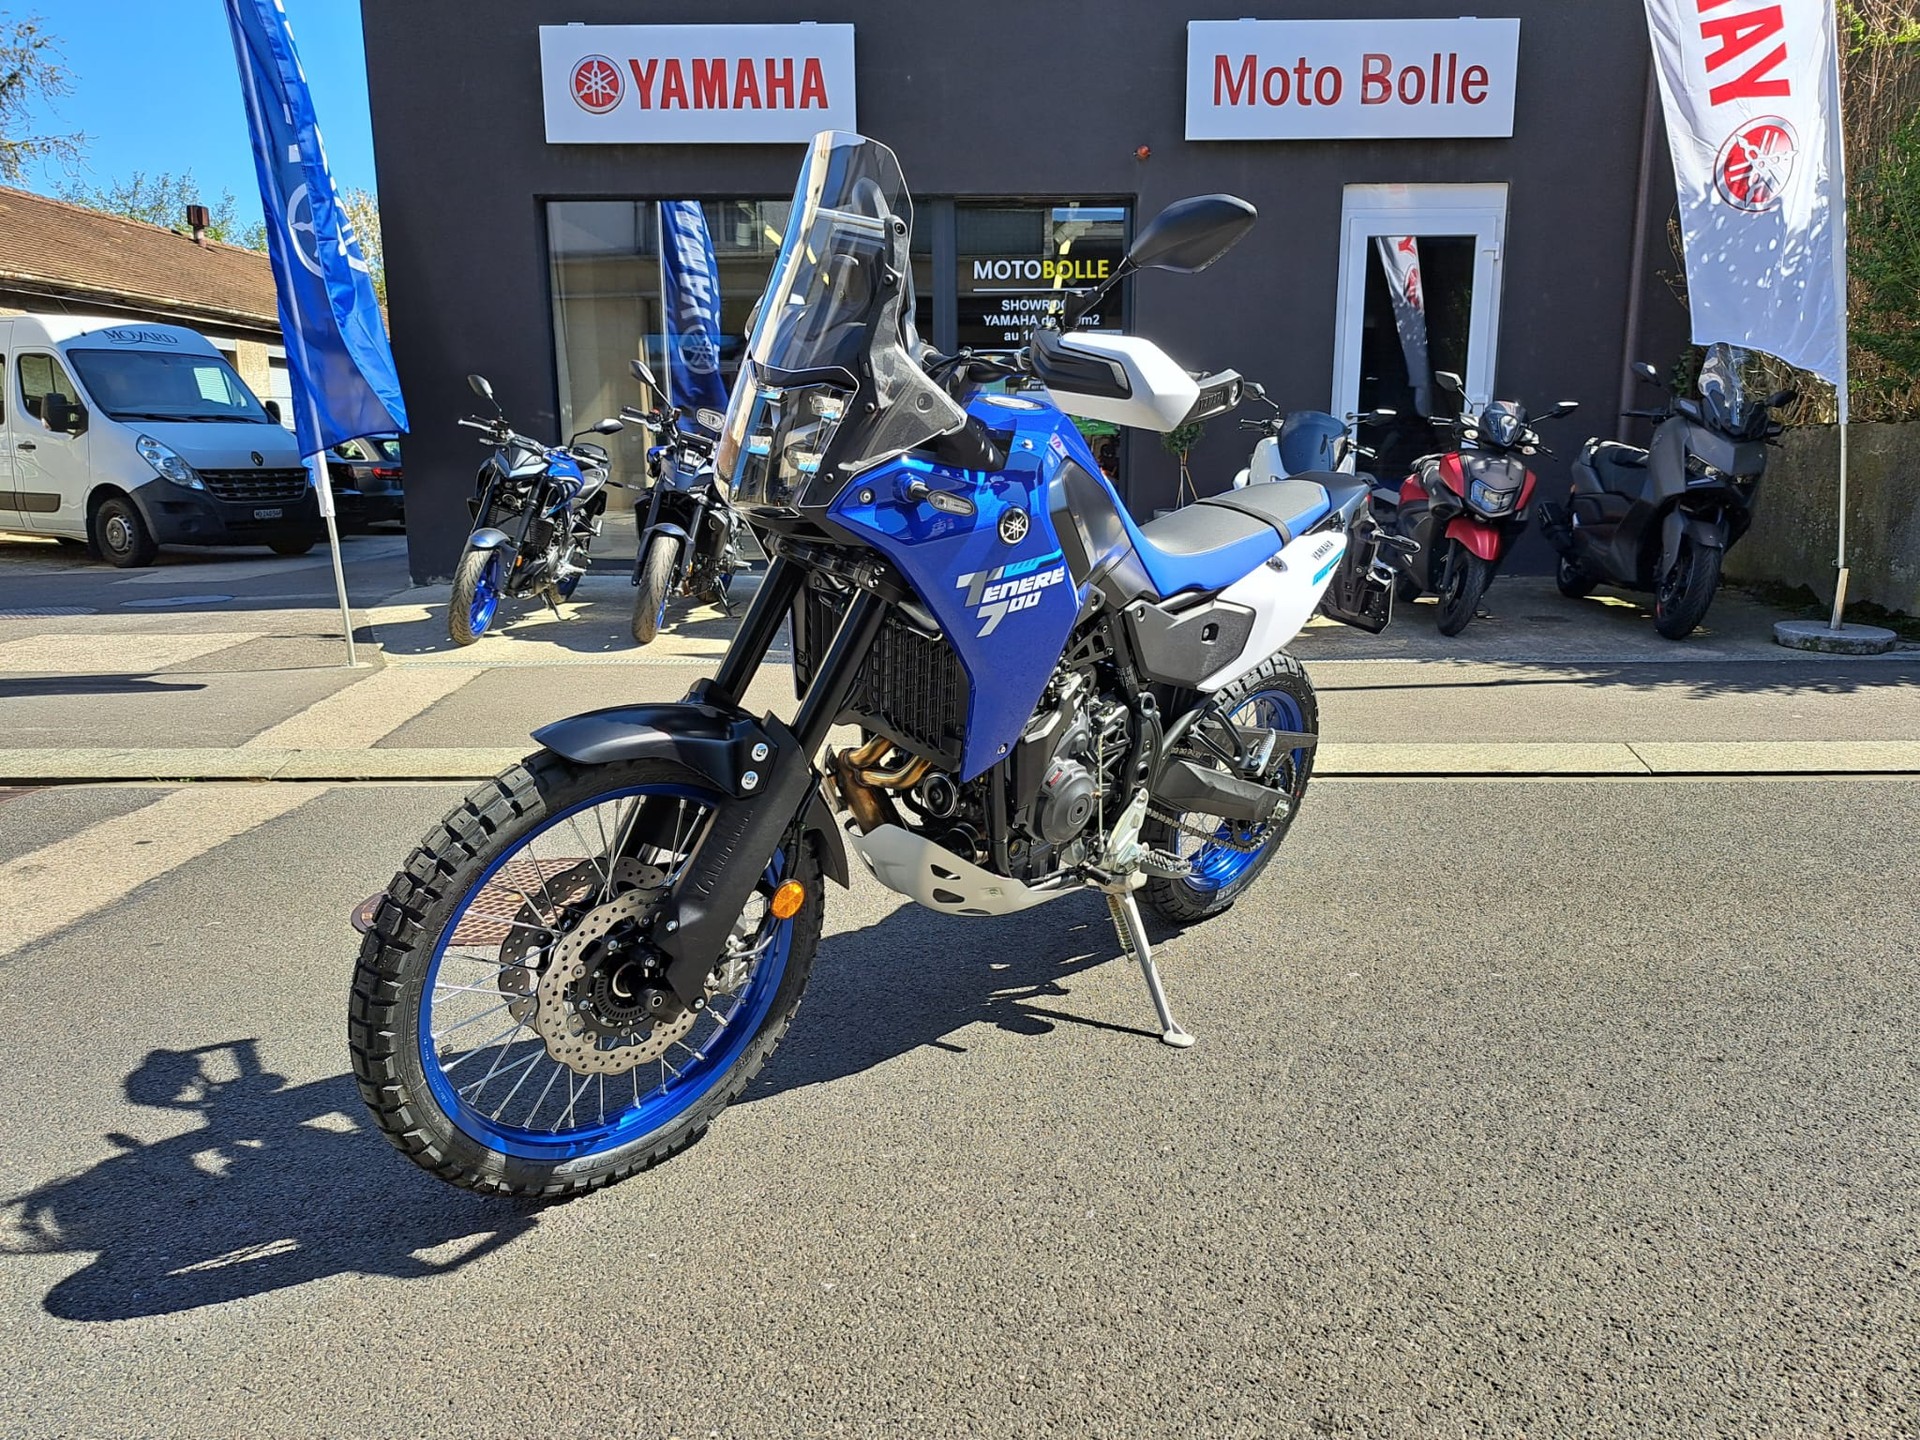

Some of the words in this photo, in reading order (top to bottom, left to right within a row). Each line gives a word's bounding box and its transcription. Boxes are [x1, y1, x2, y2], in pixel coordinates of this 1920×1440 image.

[628, 58, 829, 110] YAMAHA
[1213, 54, 1343, 106] Moto
[1360, 53, 1489, 105] Bolle
[973, 260, 1109, 279] MOTOBOLLE
[983, 315, 1038, 326] YAMAHA
[1041, 314, 1056, 326] de
[1004, 332, 1019, 341] au
[1312, 540, 1335, 560] YAMAHA
[976, 591, 1042, 638] 700
